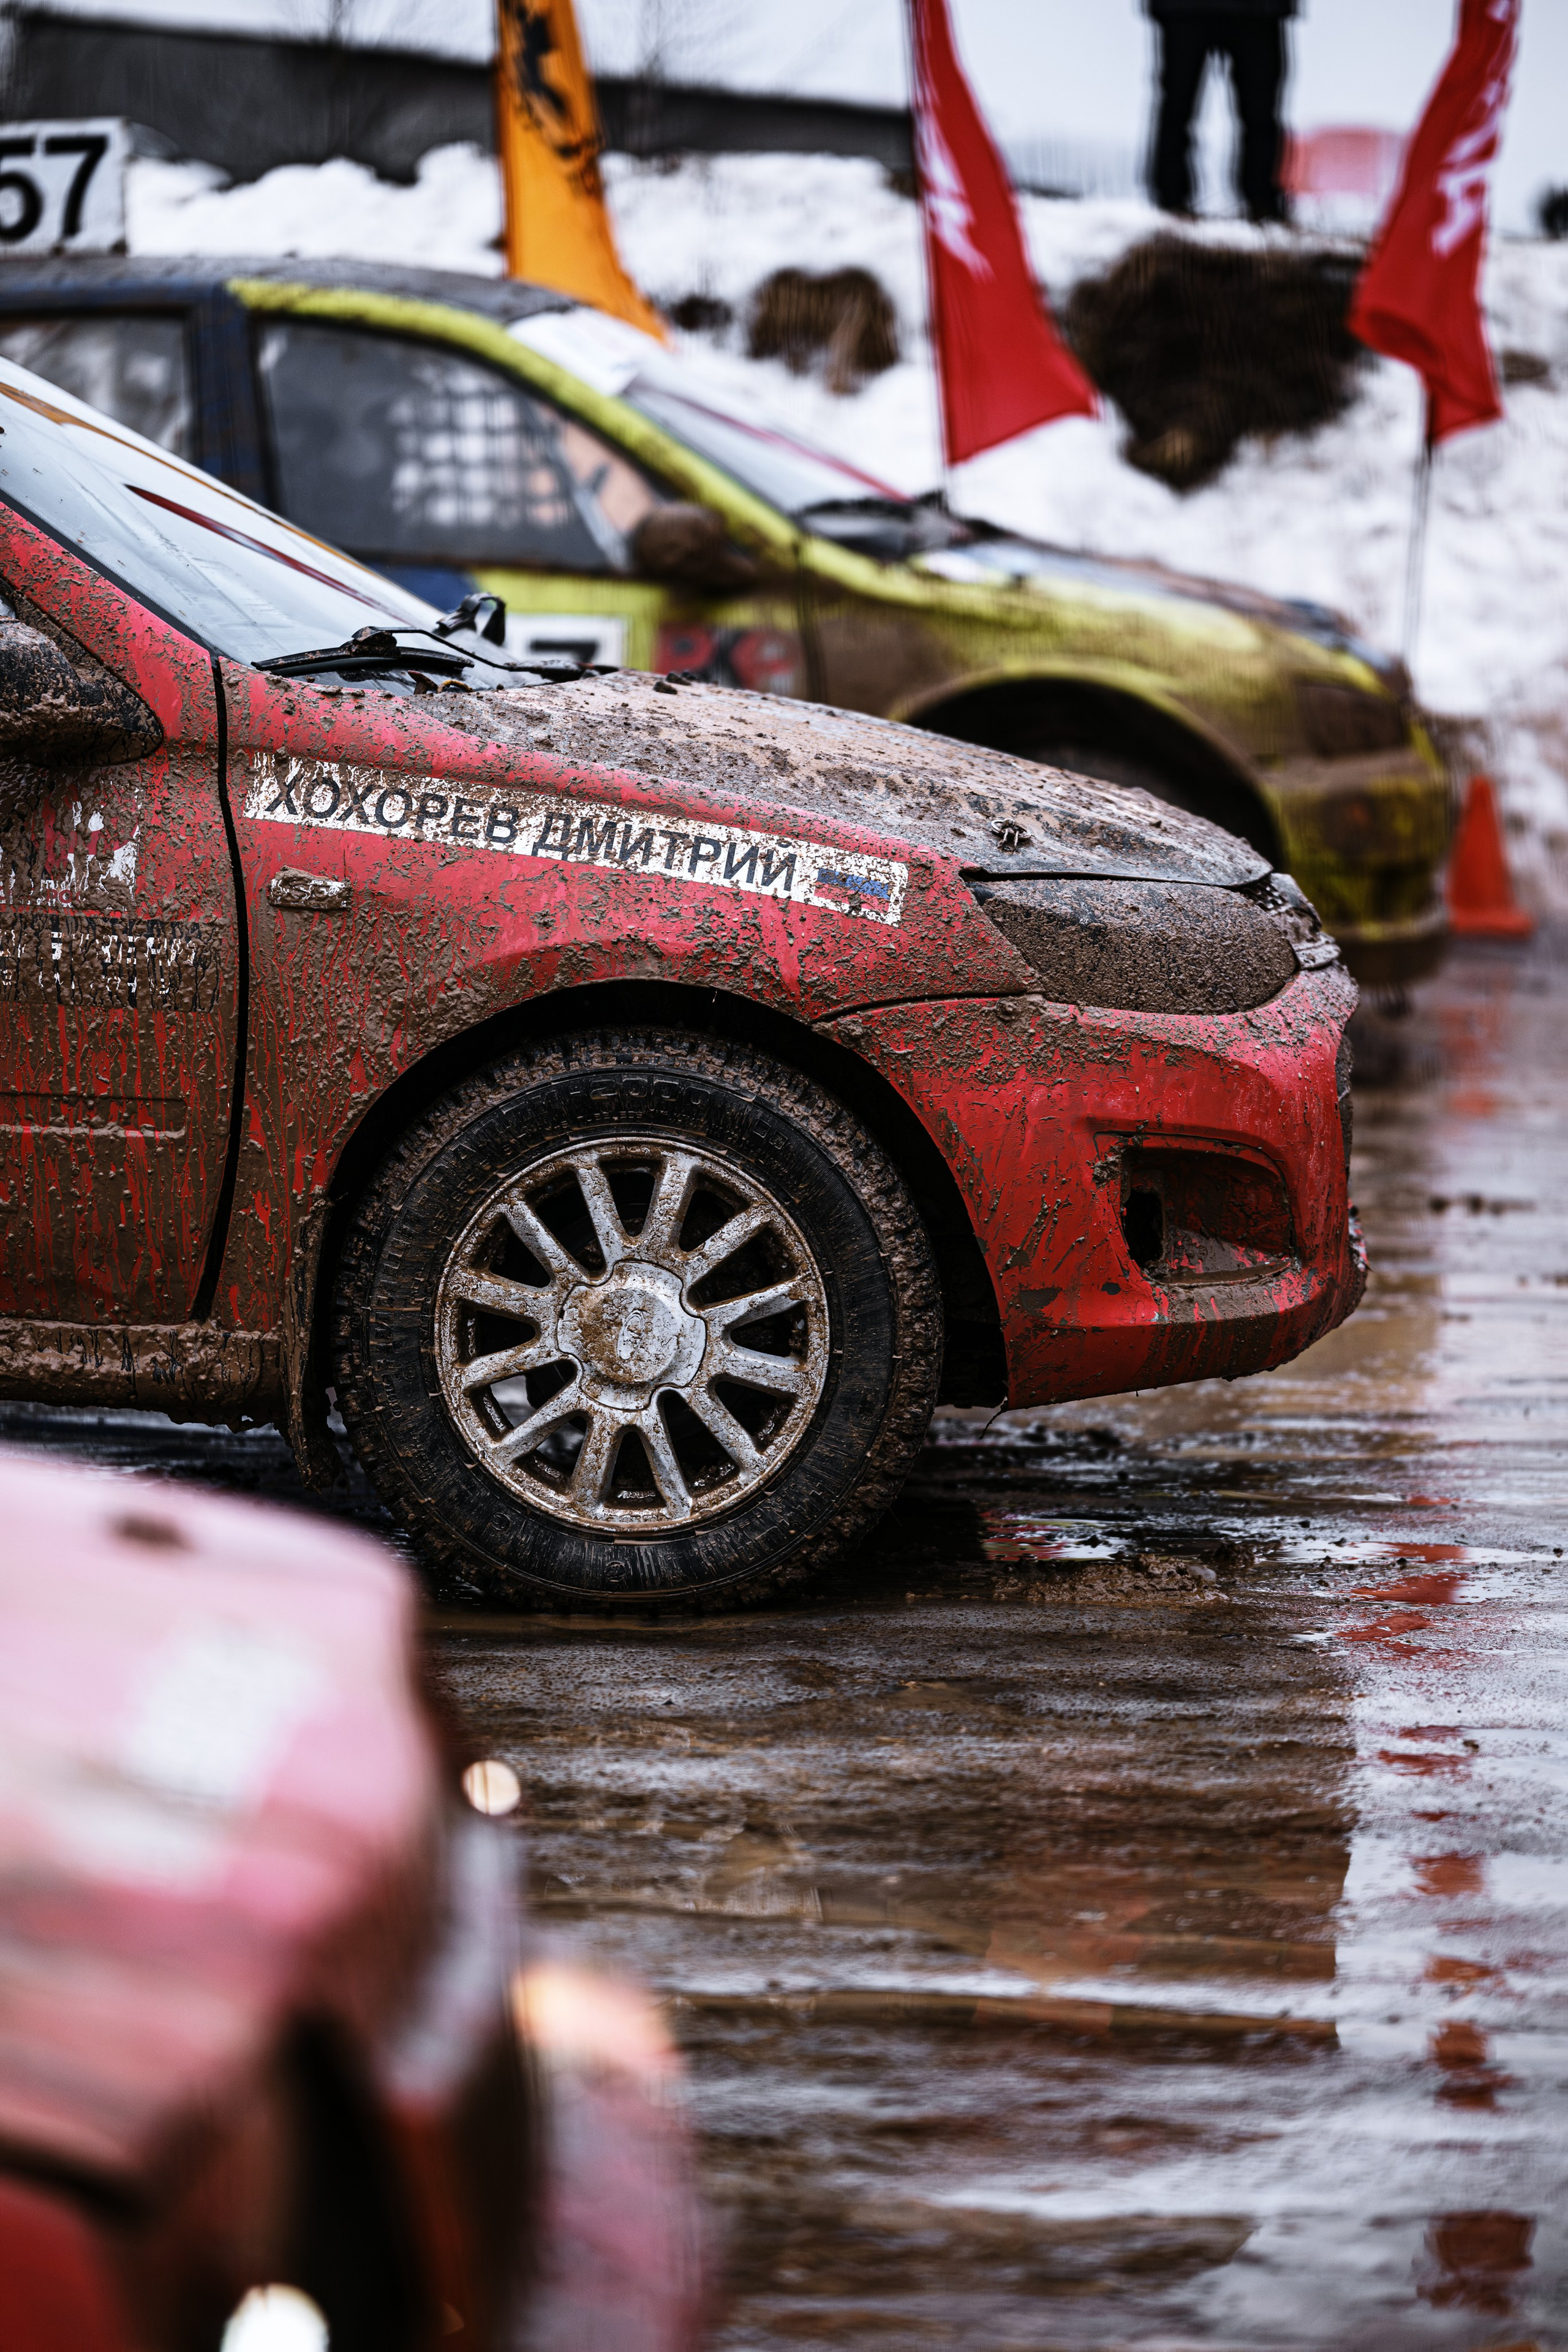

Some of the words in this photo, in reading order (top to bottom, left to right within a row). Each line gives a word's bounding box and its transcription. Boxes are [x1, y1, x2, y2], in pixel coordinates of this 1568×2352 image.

[0, 136, 108, 243] 57
[266, 768, 518, 843] ХОХОРЕВ
[533, 811, 798, 893] ДМИТРИЙ
